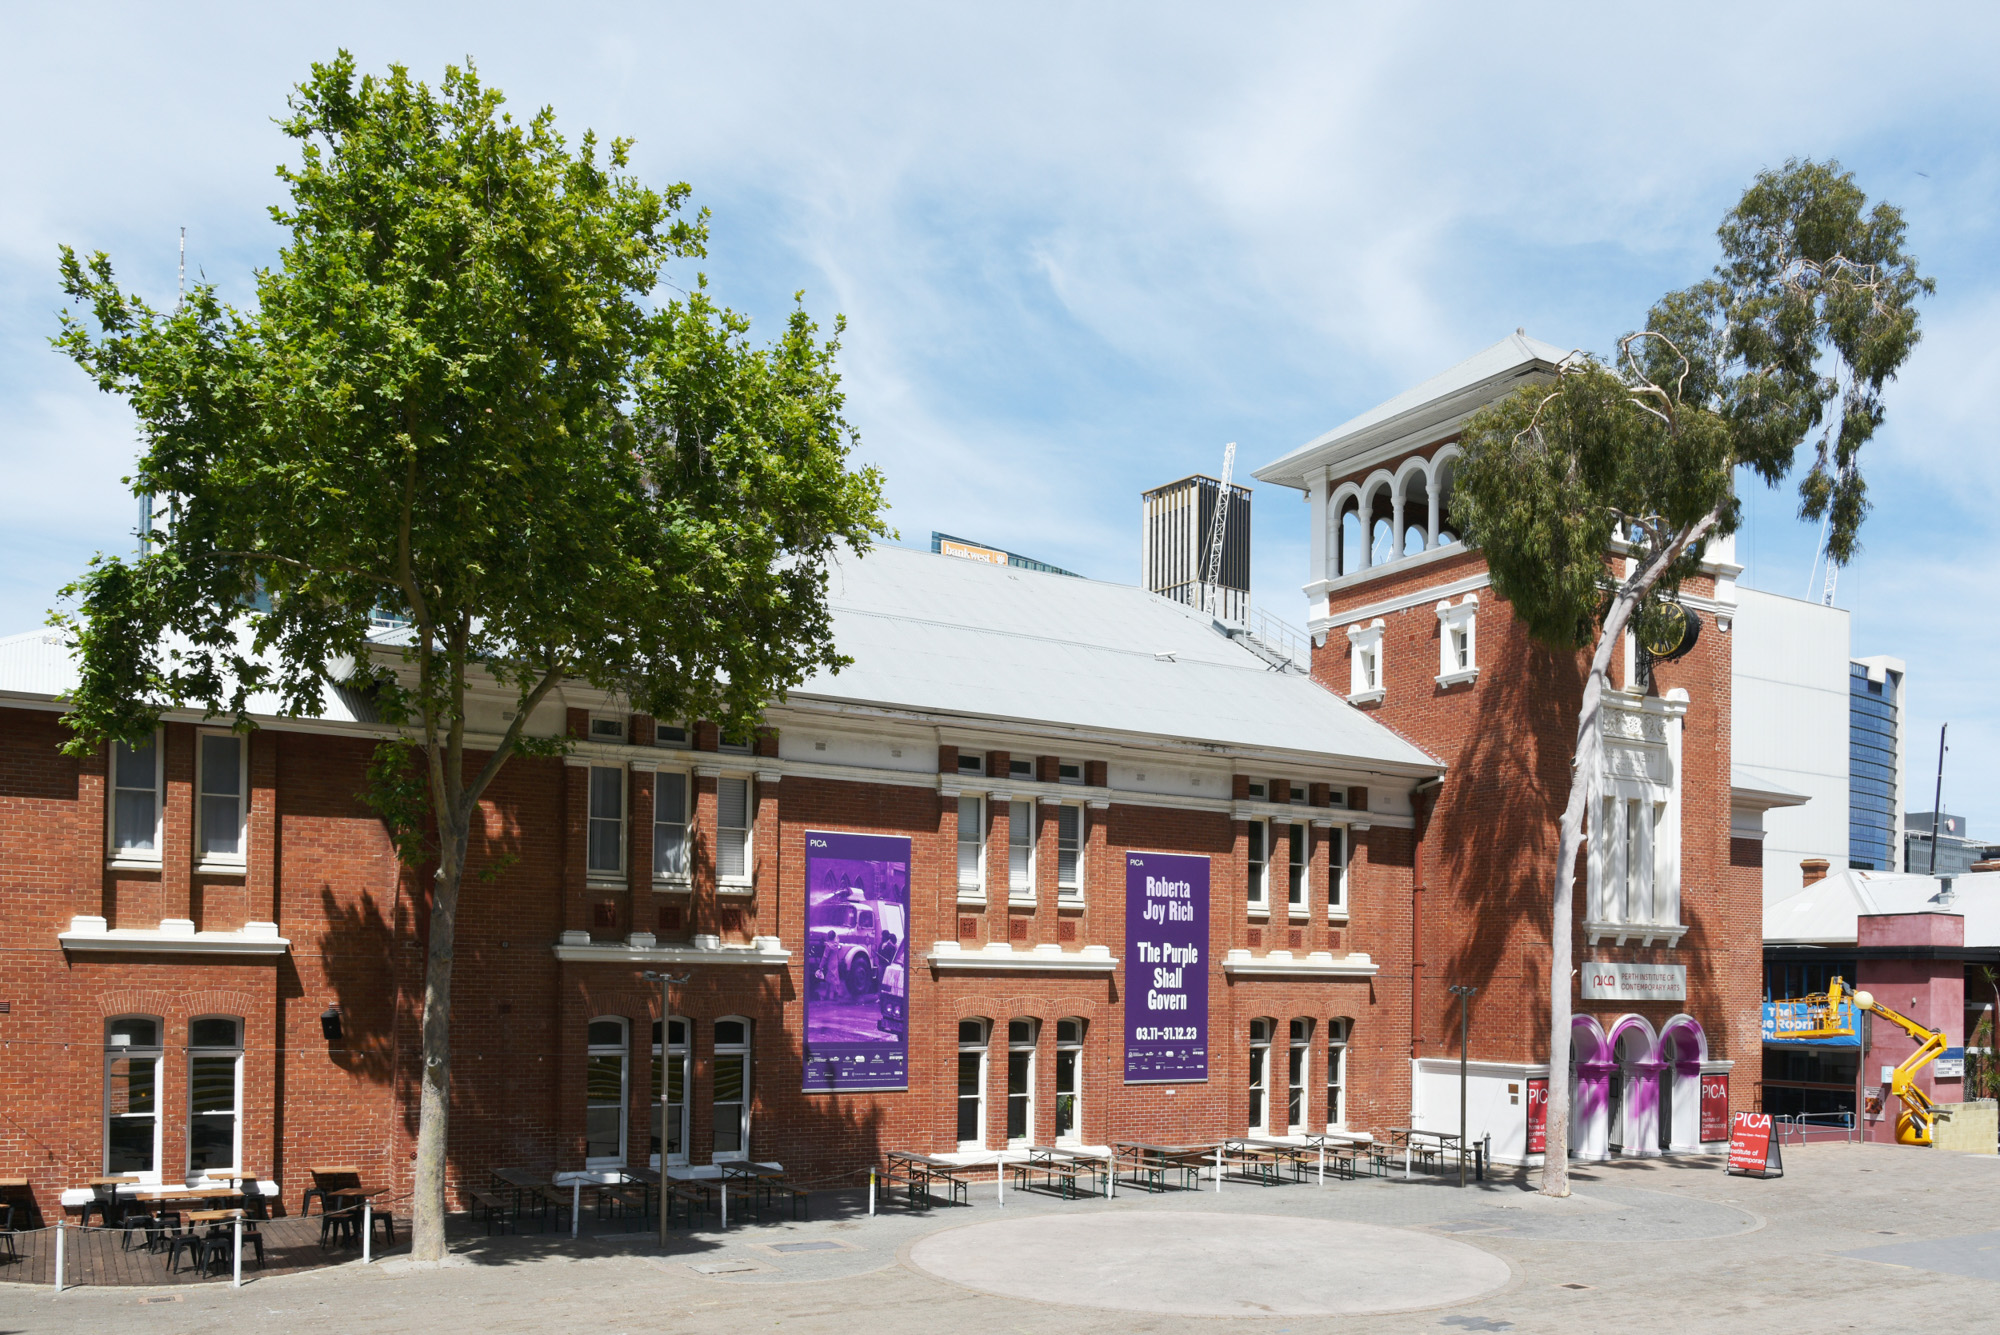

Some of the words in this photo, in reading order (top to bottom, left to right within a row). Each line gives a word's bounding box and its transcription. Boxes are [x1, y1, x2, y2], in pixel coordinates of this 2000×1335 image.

[946, 544, 990, 562] bankwest
[810, 839, 828, 847] PICA
[1146, 876, 1191, 898] Roberta
[1143, 899, 1166, 925] Joy
[1169, 900, 1194, 921] Rich
[1137, 942, 1161, 963] The
[1163, 943, 1198, 968] Purple
[1153, 967, 1182, 988] Shall
[1621, 972, 1638, 980] PERTH
[1640, 973, 1666, 981] INSTITUTE
[1621, 983, 1665, 991] CONTEMPORARY
[1667, 984, 1680, 992] ARTS
[1147, 989, 1187, 1010] Govern
[1762, 1020, 1774, 1029] ue
[1779, 1019, 1814, 1030] Room
[1529, 1088, 1548, 1104] PIC
[1702, 1084, 1726, 1099] PICA
[1734, 1112, 1771, 1129] PICA
